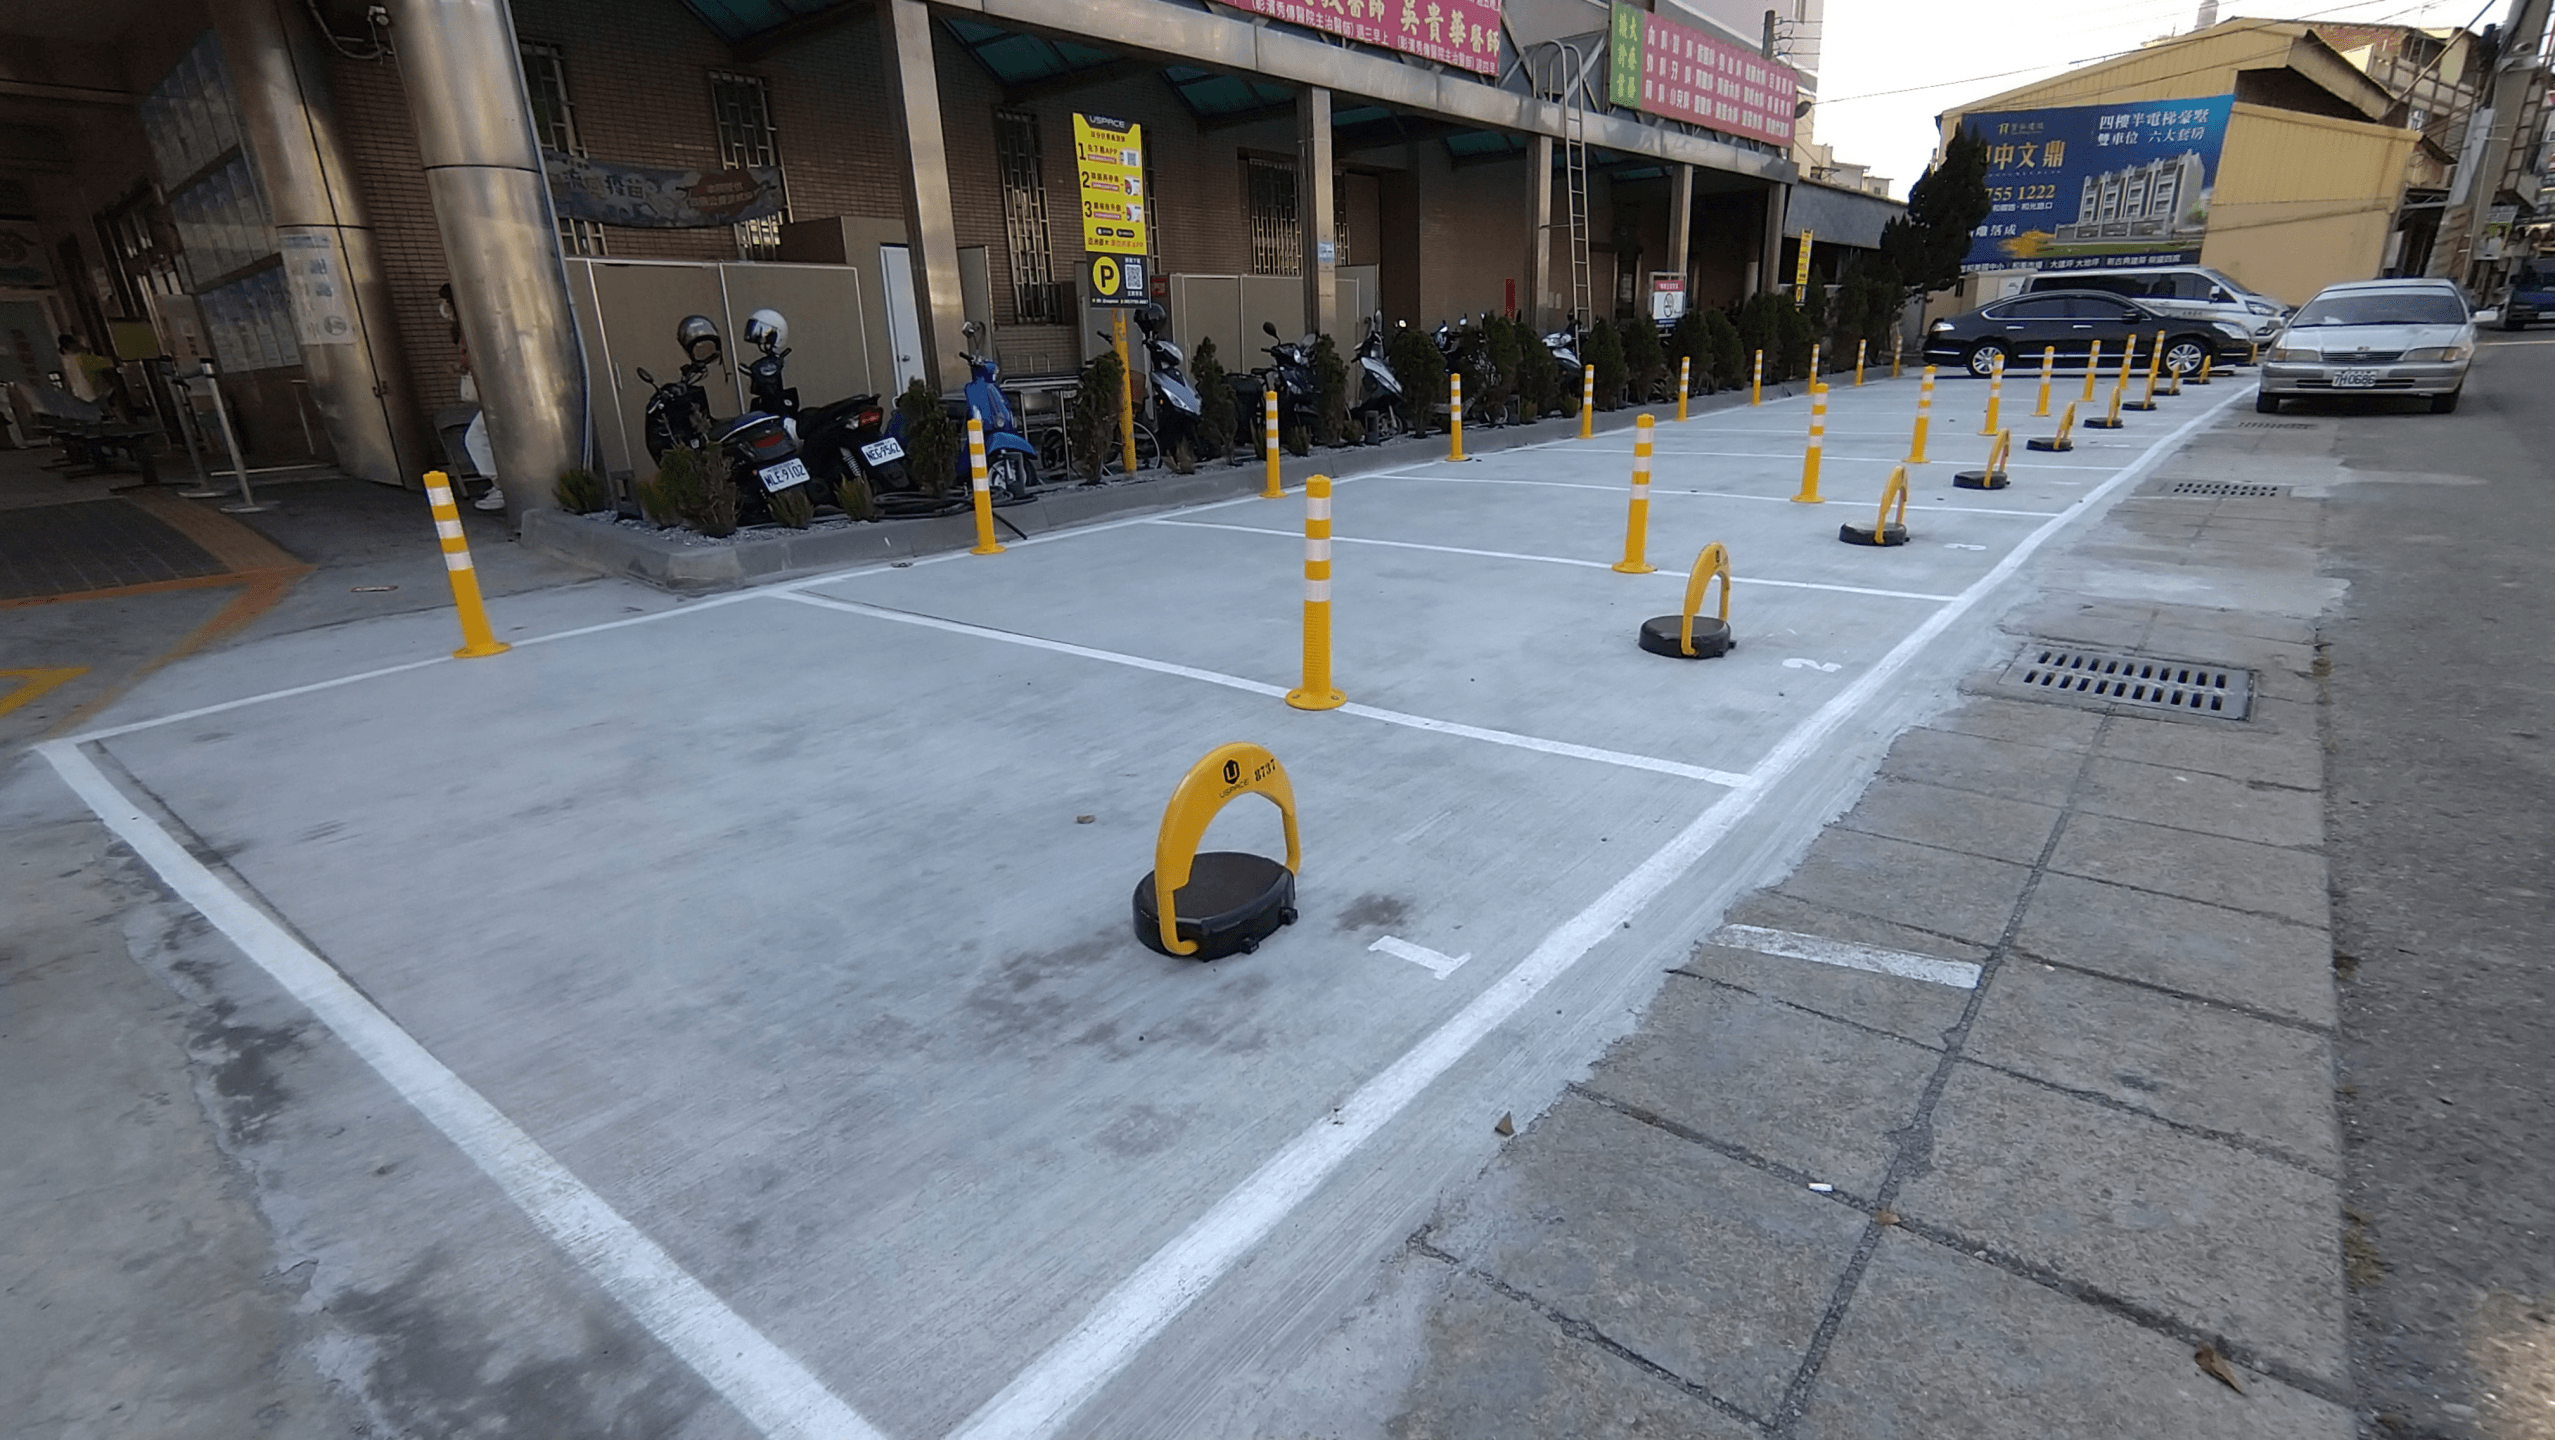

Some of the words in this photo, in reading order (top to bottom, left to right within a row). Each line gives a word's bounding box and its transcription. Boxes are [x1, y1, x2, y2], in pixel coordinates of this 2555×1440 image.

[1089, 115, 1125, 129] USPACE
[2099, 109, 2210, 130] 四樓半電梯豪墅
[2098, 131, 2139, 146] 雙車位
[2147, 126, 2206, 143] 六大套房
[1078, 142, 1086, 160] 1
[1986, 140, 2065, 170] 中文鼎
[1081, 171, 1091, 189] 2
[2018, 184, 2056, 200] 1222
[1084, 201, 1092, 218] 3
[1100, 265, 1115, 288] P
[1782, 658, 1842, 673] 2
[1367, 935, 1472, 980] 1
